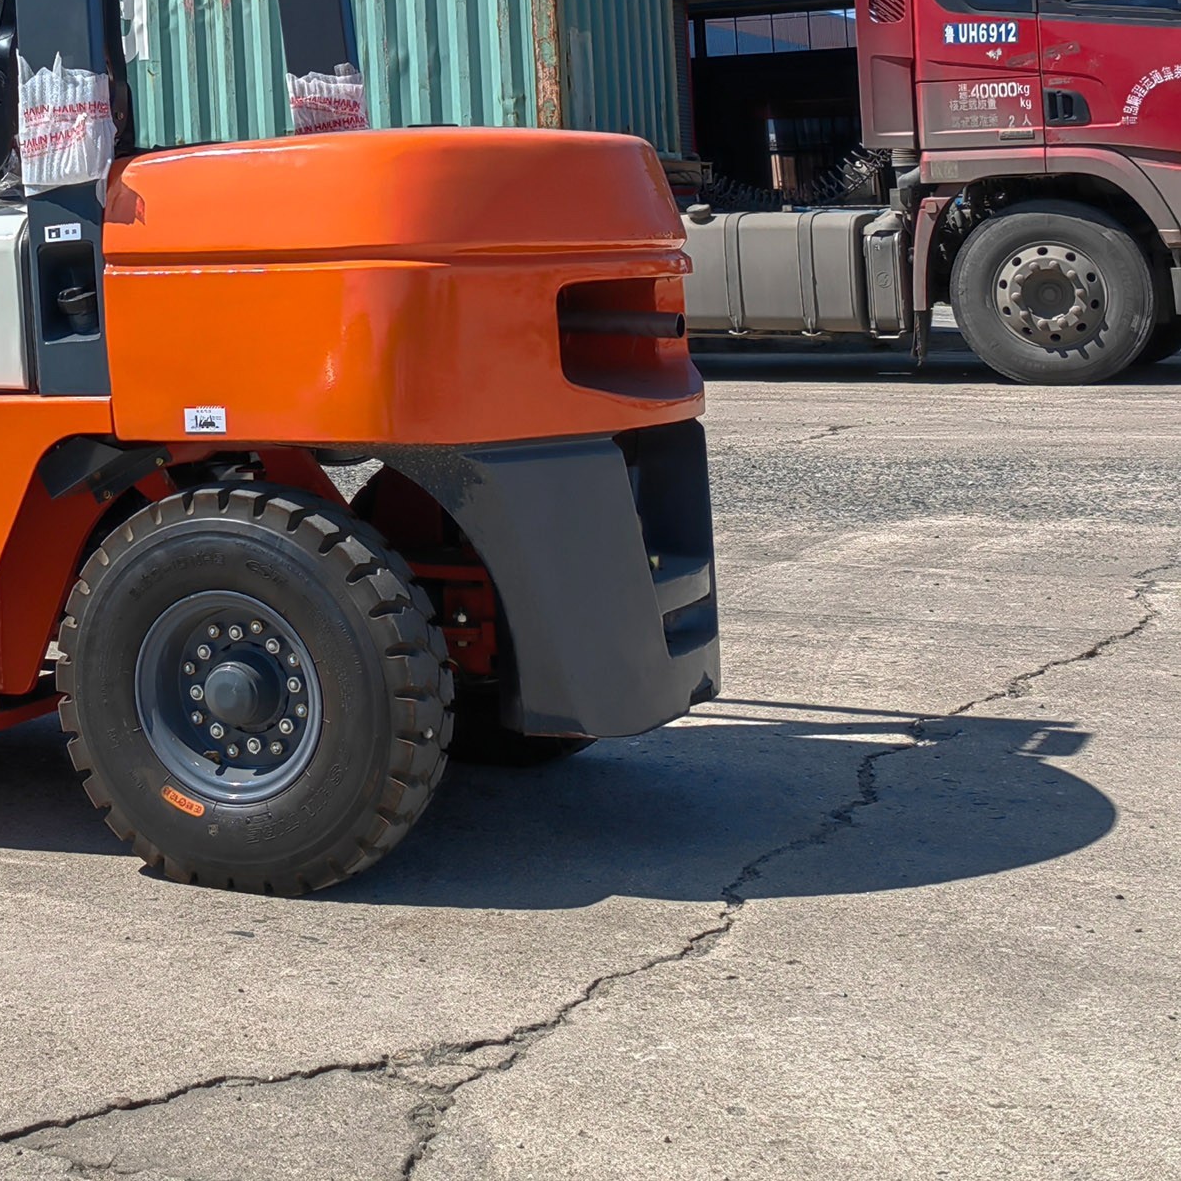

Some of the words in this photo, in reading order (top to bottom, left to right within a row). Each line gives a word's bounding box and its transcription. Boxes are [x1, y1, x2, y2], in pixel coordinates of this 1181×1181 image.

[52, 102, 86, 114] HAILIN
[333, 99, 360, 109] HAILIN
[1020, 98, 1032, 110] kg
[314, 119, 342, 131] HAILIN
[1009, 115, 1016, 128] 2
[1022, 114, 1033, 126] 人
[20, 134, 48, 149] HAILIN
